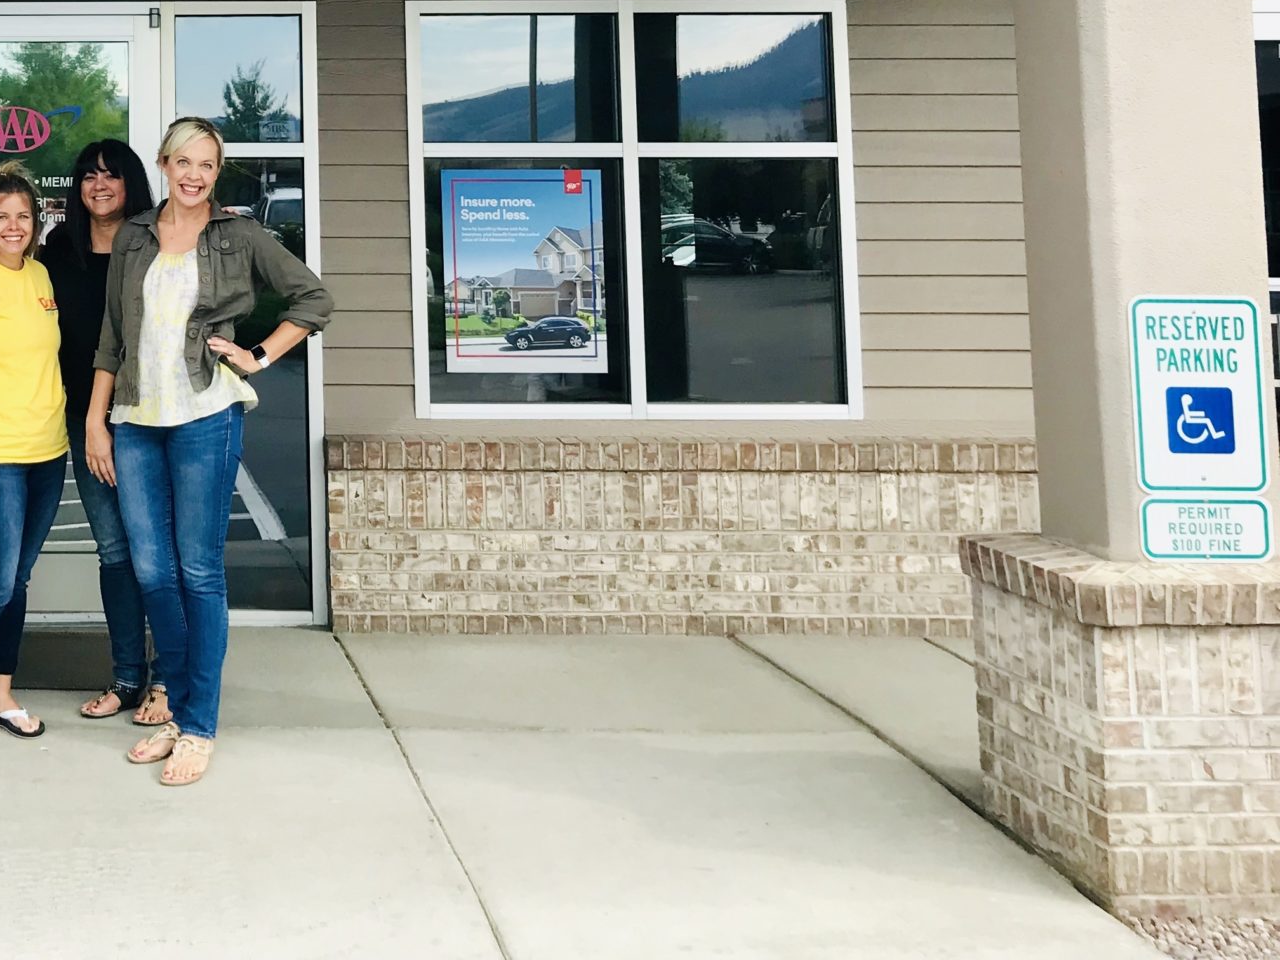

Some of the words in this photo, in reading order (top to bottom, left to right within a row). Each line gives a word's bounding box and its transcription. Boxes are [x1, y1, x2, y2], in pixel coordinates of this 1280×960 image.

[41, 177, 73, 187] MEM
[460, 196, 498, 208] Insure
[500, 197, 536, 208] more.
[460, 209, 501, 223] Spend
[503, 209, 530, 221] less.
[1145, 315, 1245, 341] RESERVED
[1156, 347, 1239, 373] PARKING
[1178, 507, 1231, 520] PERMIT
[1168, 522, 1244, 536] REQUIRED
[1172, 538, 1201, 552] $100
[1209, 539, 1242, 552] FINE
